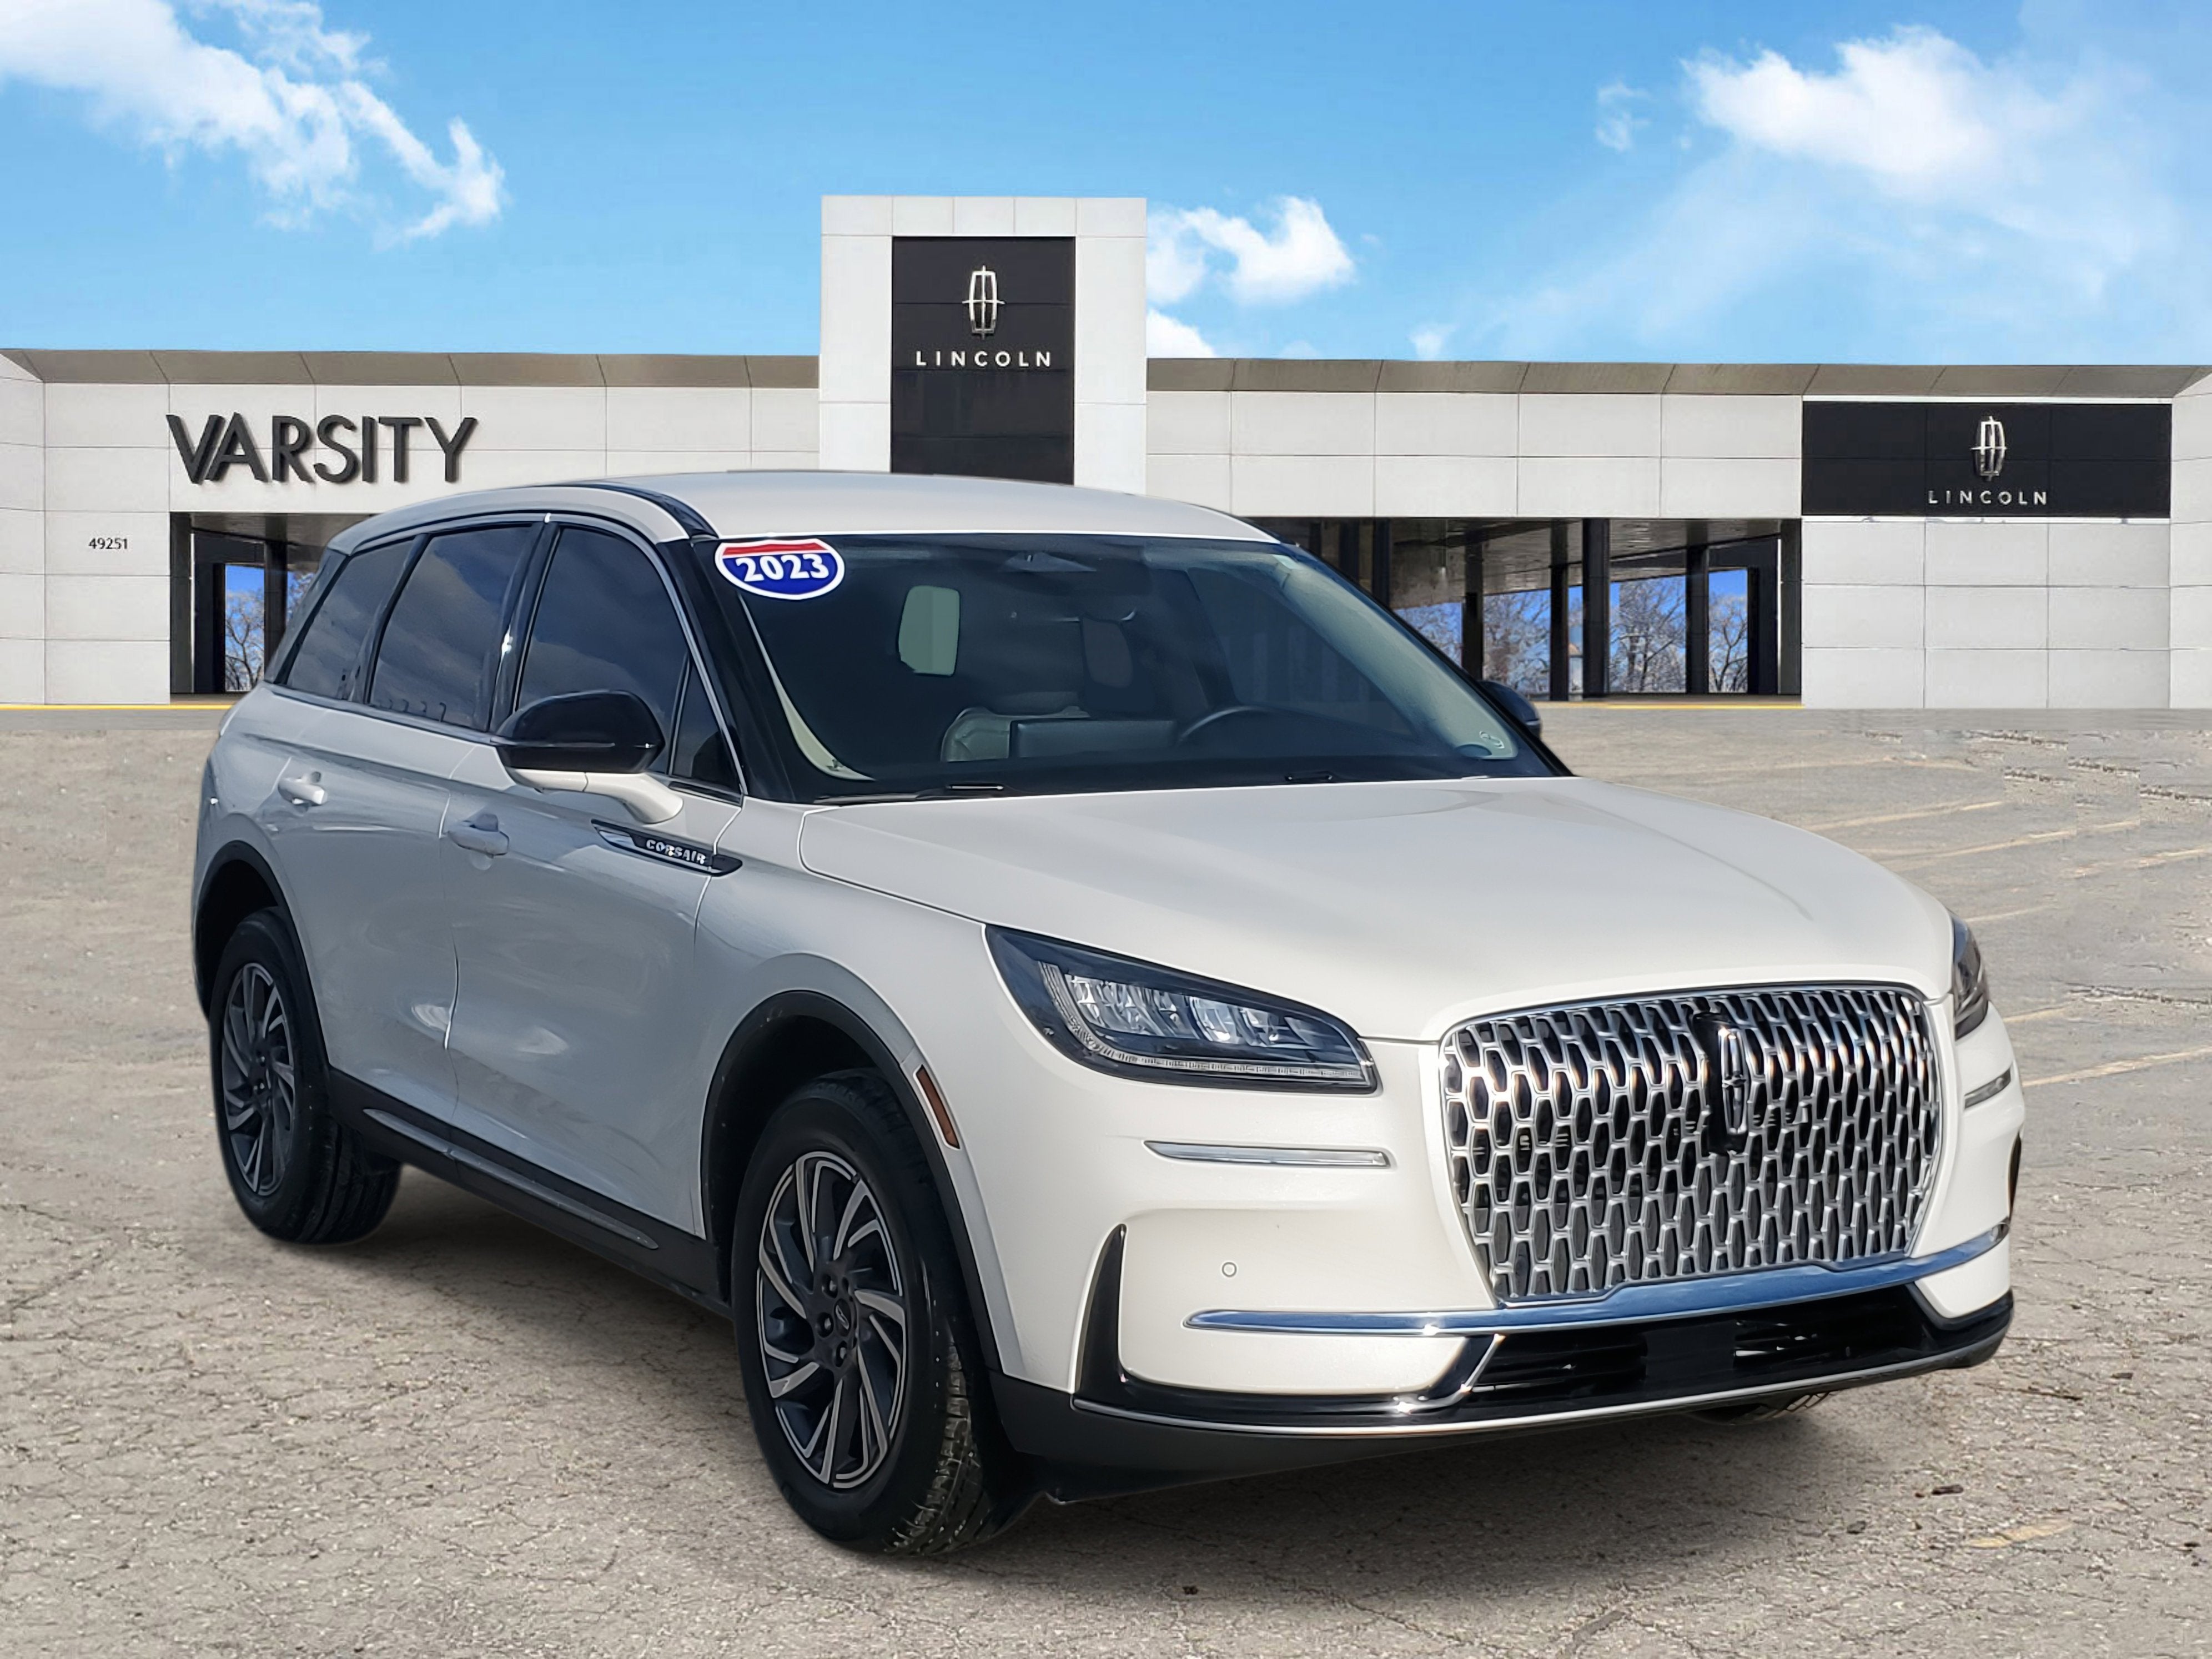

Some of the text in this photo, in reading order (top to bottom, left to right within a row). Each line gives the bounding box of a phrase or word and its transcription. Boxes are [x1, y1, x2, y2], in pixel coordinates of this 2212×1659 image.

[916, 350, 1050, 367] LINCOLN
[166, 411, 478, 485] VARSITY
[1928, 490, 2047, 505] LINCOLN
[88, 537, 128, 549] 49251
[735, 554, 829, 582] 2023
[646, 839, 706, 864] CORSAIR
